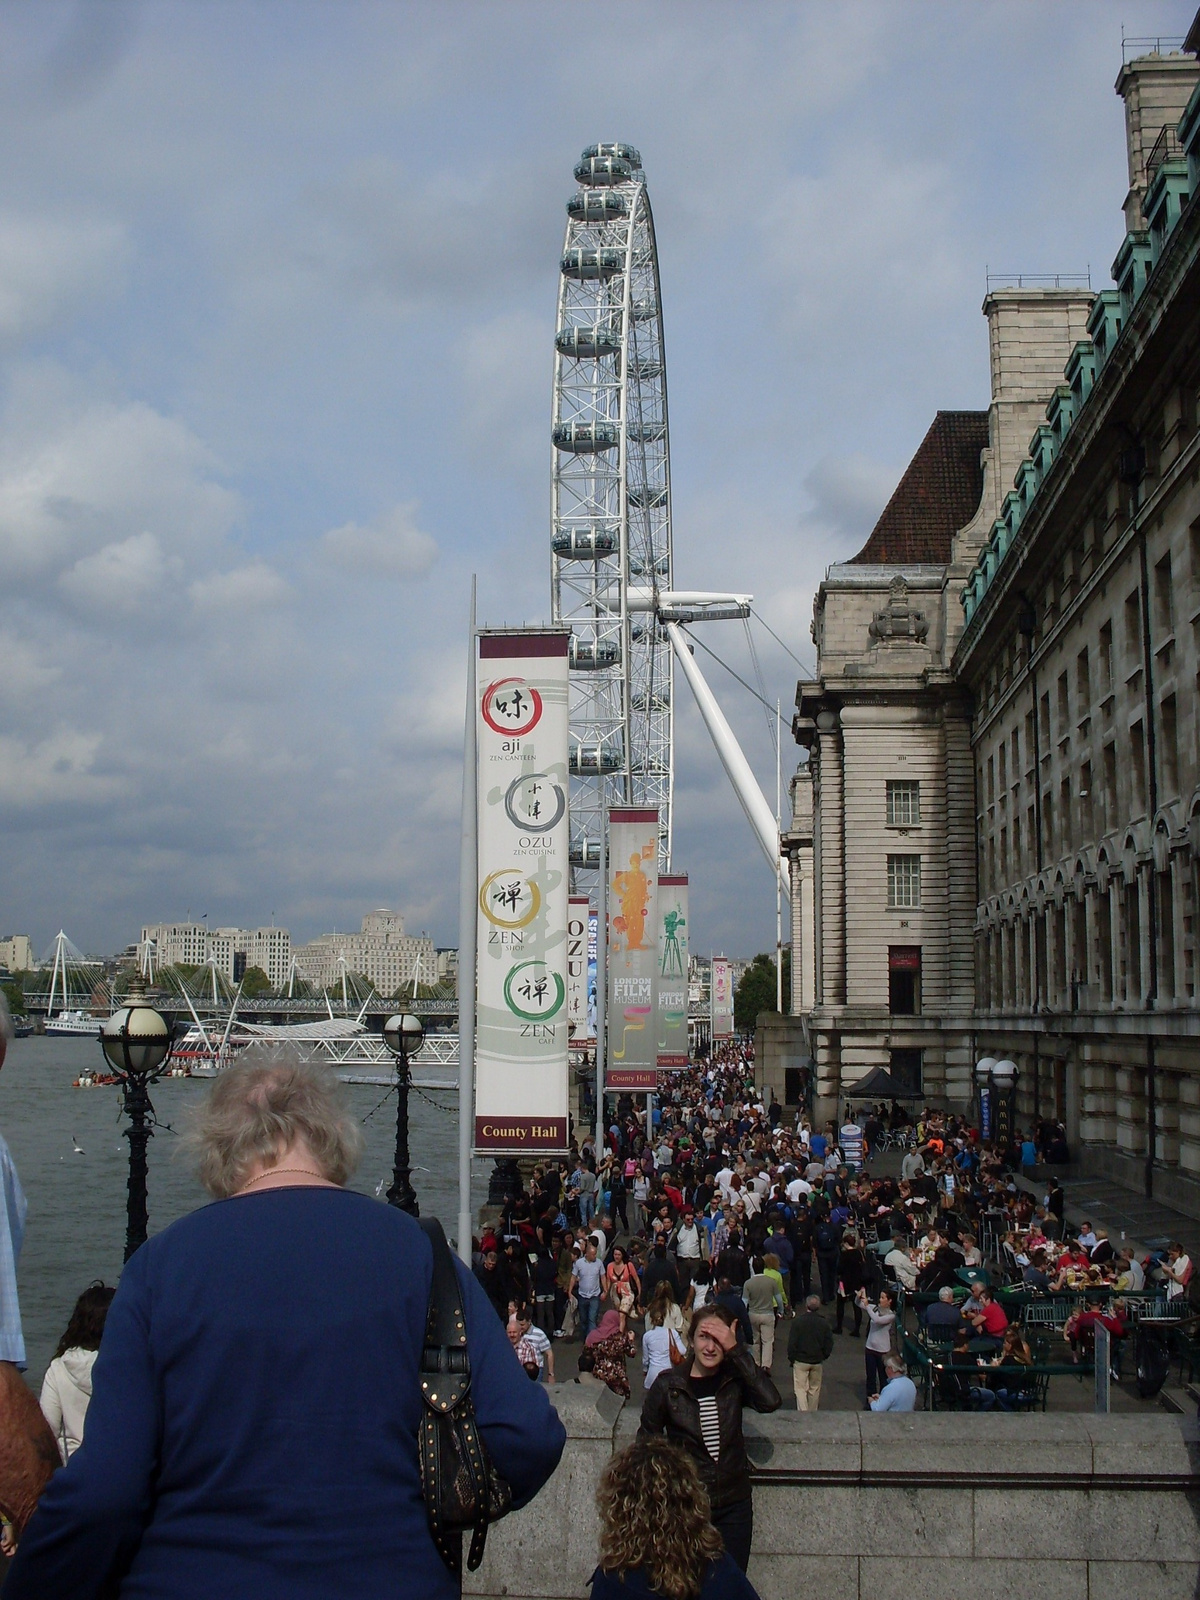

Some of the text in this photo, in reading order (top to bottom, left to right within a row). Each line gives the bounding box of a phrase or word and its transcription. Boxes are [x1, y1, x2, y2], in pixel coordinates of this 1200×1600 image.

[496, 689, 528, 719] 味
[502, 739, 520, 755] aji
[518, 837, 553, 849] OZU
[488, 931, 524, 944] ZEN
[568, 919, 584, 978] OZU
[614, 985, 652, 996] FILM
[613, 996, 651, 1004] MUSEUM
[658, 996, 684, 1005] FILM
[520, 1024, 556, 1037] ZEN
[611, 1075, 634, 1083] County
[482, 1125, 557, 1140] County Hall
